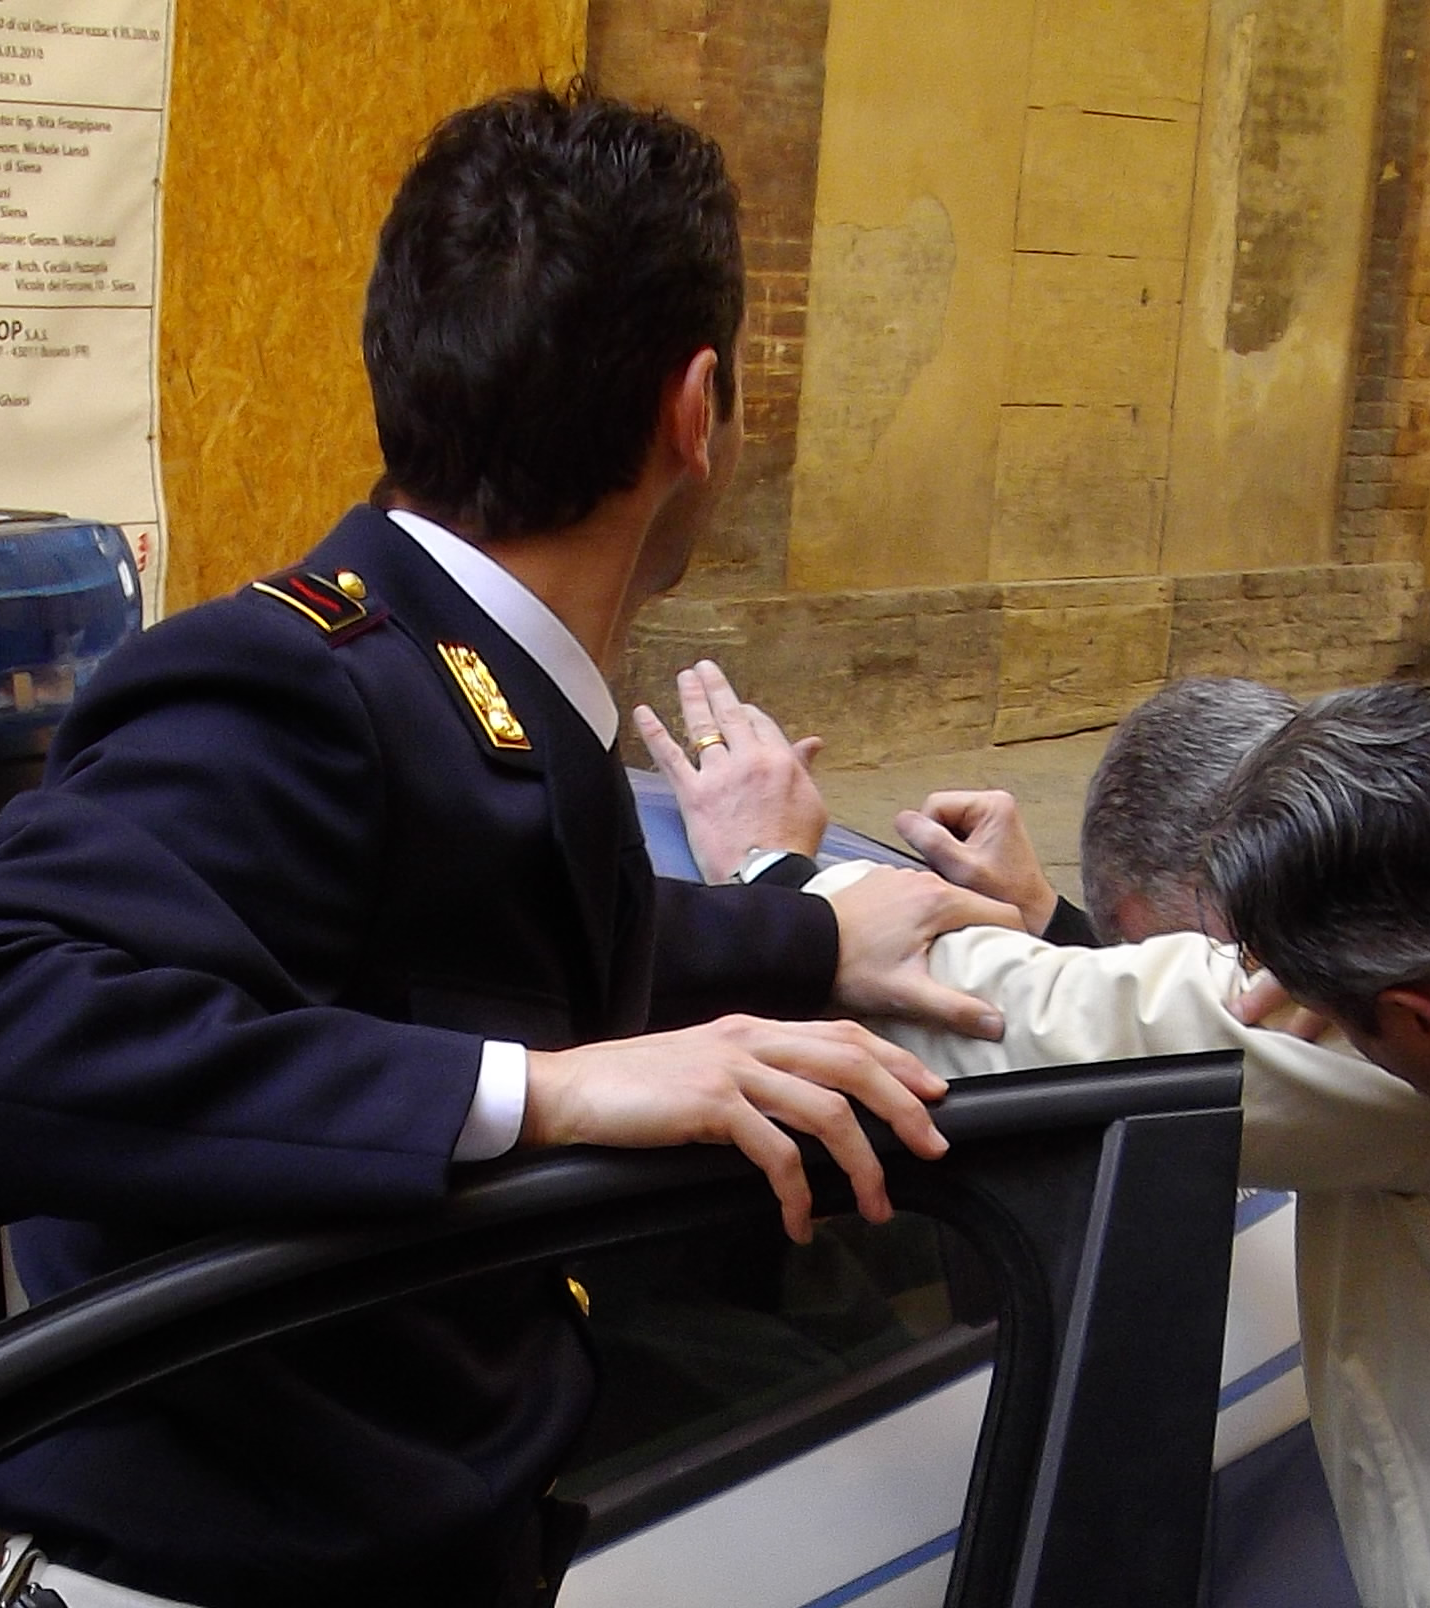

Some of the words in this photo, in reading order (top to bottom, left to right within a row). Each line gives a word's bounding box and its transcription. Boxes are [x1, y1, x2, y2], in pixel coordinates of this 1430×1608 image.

[18, 20, 30, 31] cui
[36, 116, 55, 128] Rita
[23, 142, 59, 154] Michele
[4, 160, 12, 171] di
[17, 161, 42, 173] Siena
[0, 205, 27, 218] Siena
